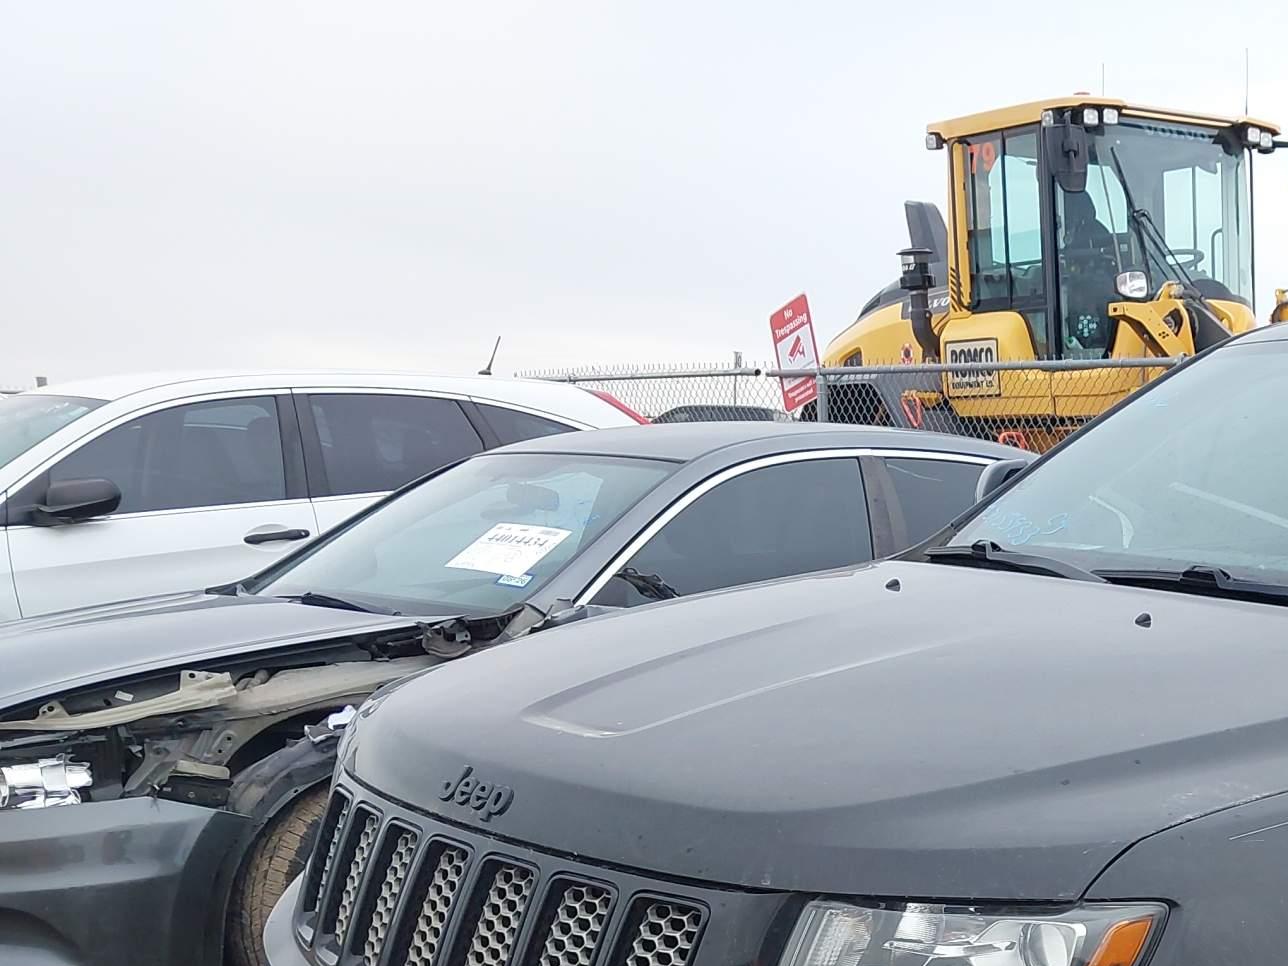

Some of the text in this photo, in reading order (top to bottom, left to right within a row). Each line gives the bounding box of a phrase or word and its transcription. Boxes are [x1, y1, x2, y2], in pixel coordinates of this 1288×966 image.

[775, 312, 808, 339] Trespassing
[783, 308, 793, 321] No
[950, 346, 994, 379] ROMCO
[439, 764, 515, 823] Jeep
